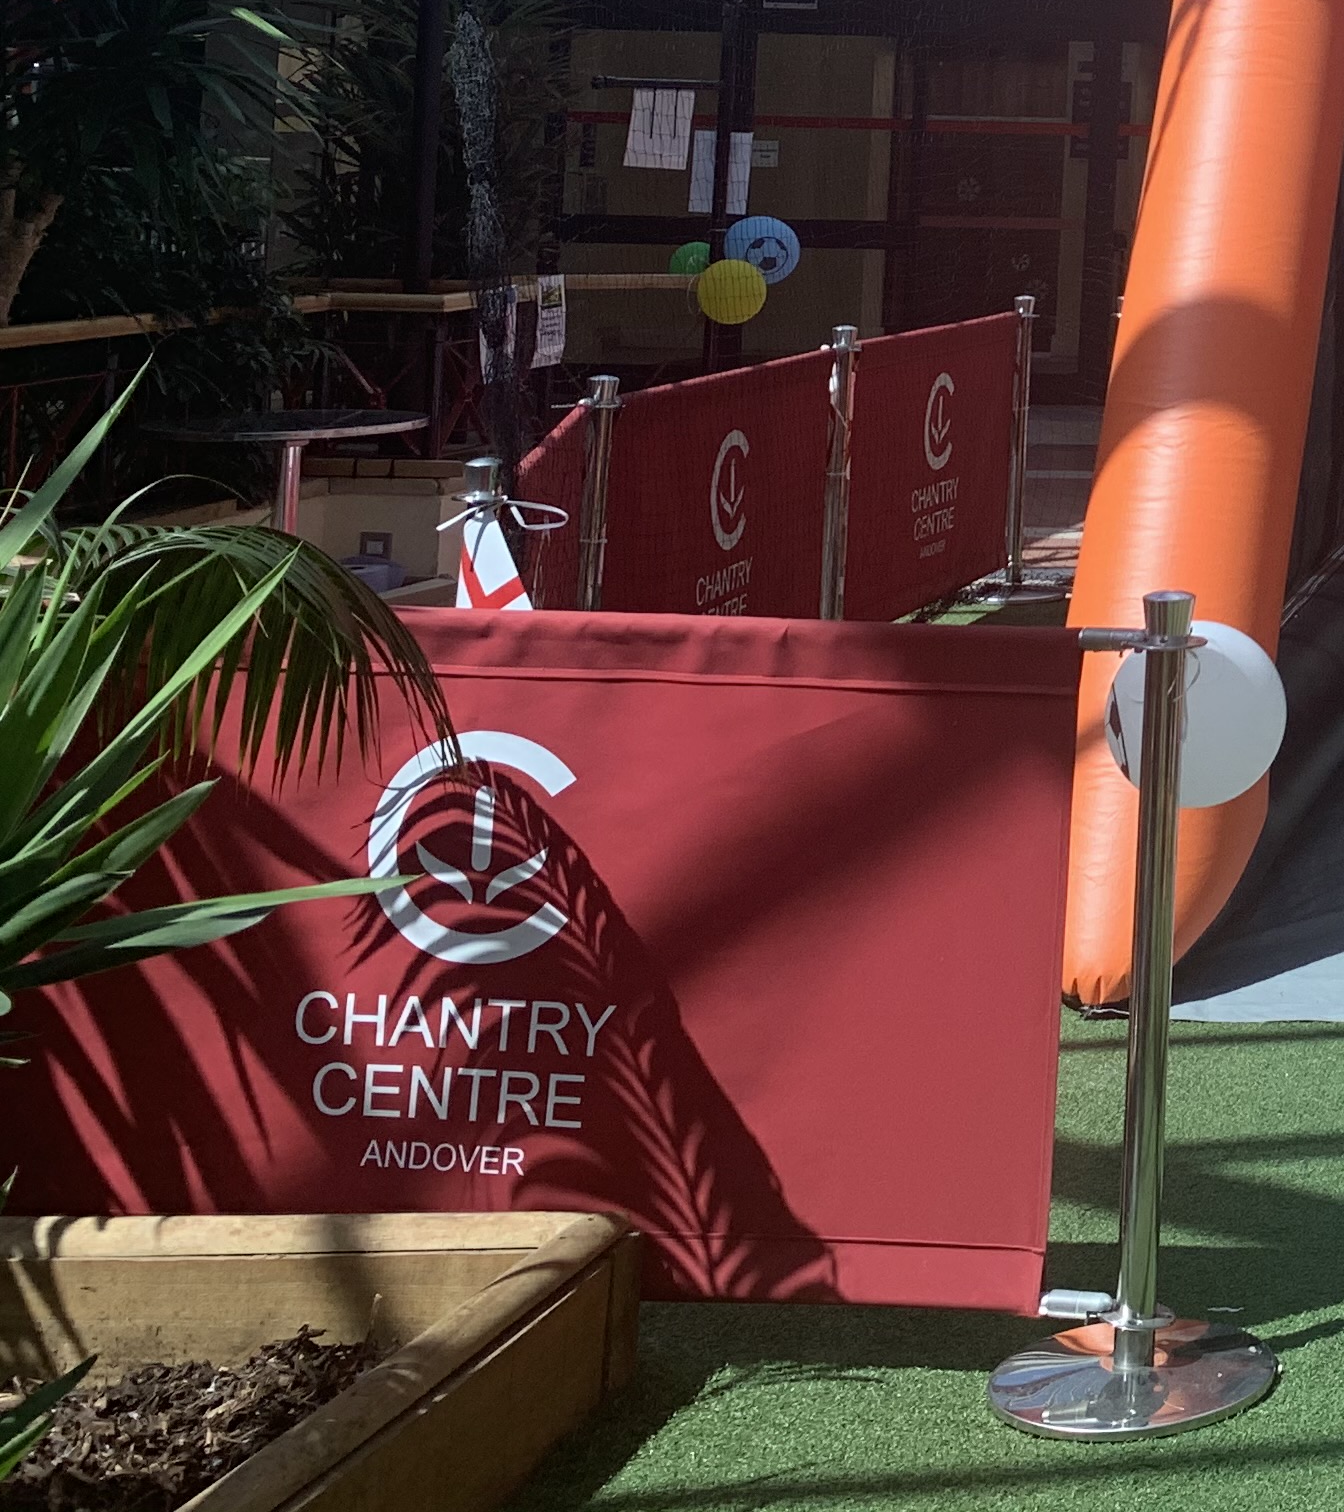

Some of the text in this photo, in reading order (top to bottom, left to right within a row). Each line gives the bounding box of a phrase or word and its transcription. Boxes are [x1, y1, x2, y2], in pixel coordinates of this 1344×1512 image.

[911, 477, 959, 513] CHANTRY
[914, 506, 955, 541] CENTRE
[696, 556, 753, 606] CHANTRY
[295, 990, 617, 1058] CHANTRY
[312, 1061, 586, 1130] CENTRE
[360, 1138, 525, 1176] ANDOVER
